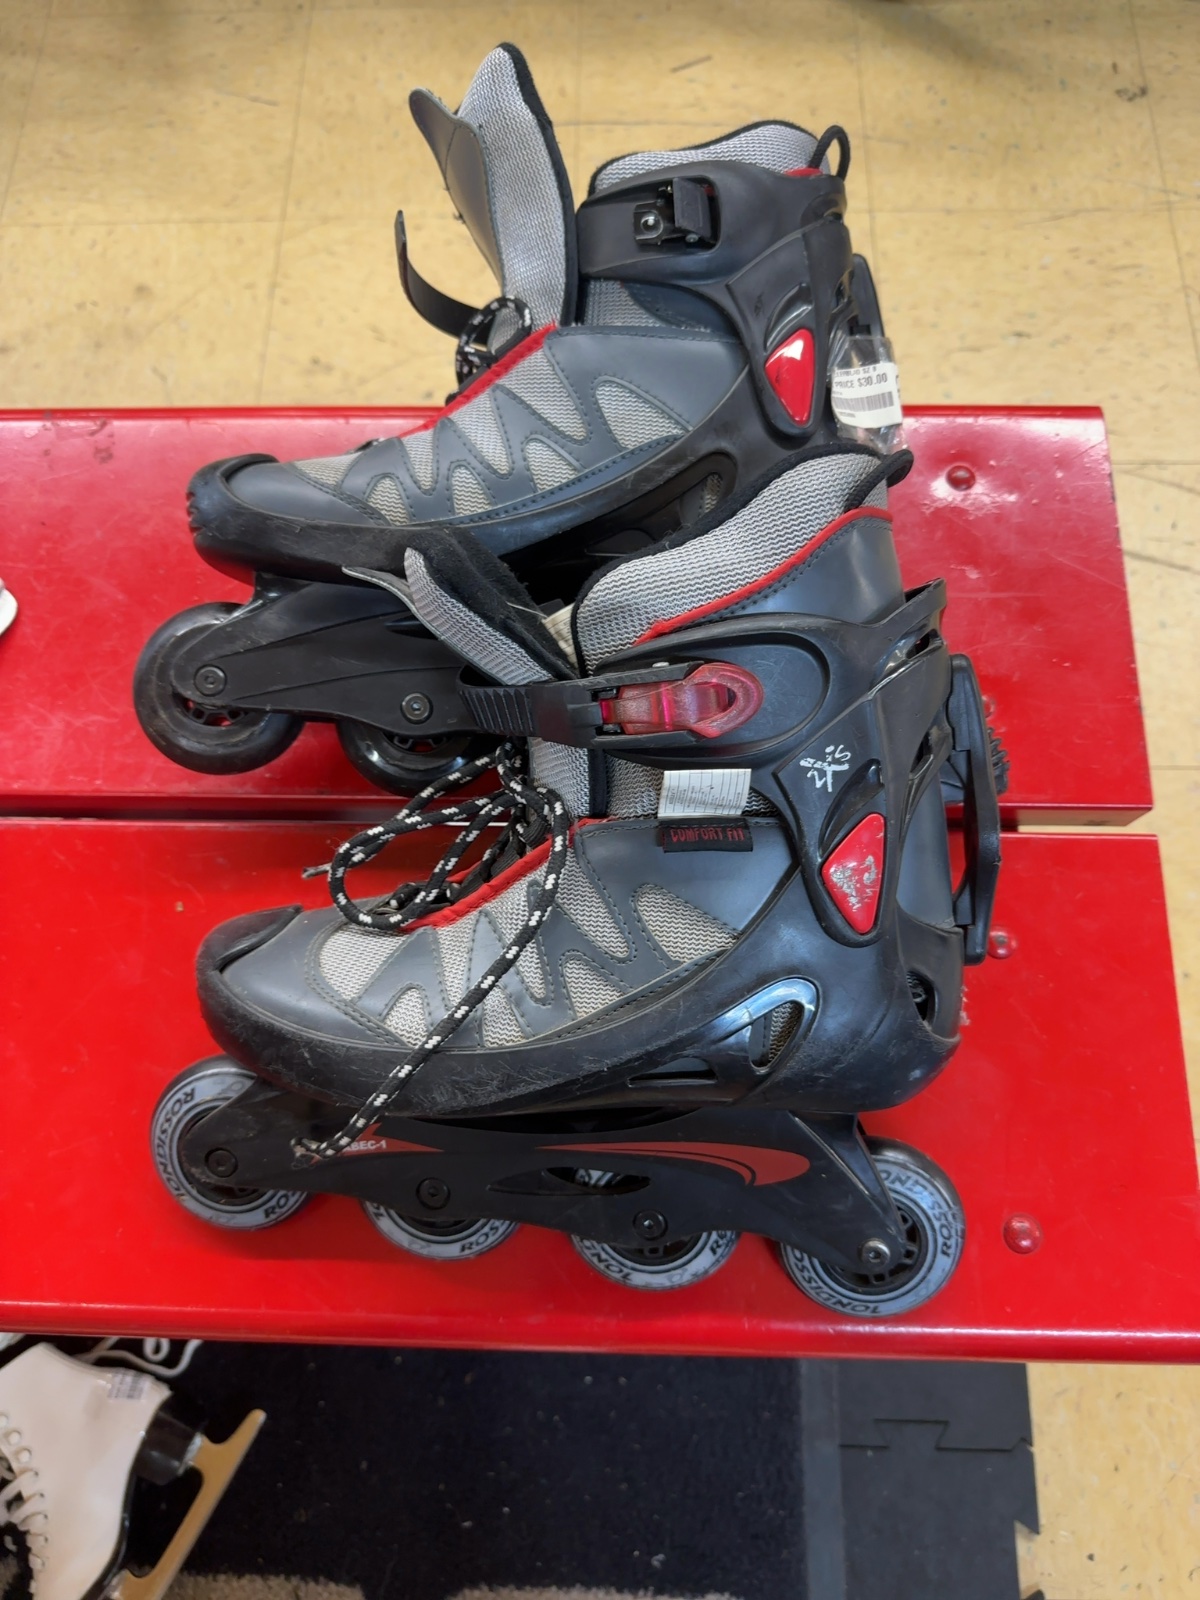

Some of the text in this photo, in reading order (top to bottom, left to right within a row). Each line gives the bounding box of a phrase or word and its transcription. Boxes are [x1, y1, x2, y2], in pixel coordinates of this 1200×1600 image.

[857, 372, 888, 387] $30.00
[670, 827, 723, 842] COMFORT
[155, 1086, 196, 1199] ROSSIGNOL
